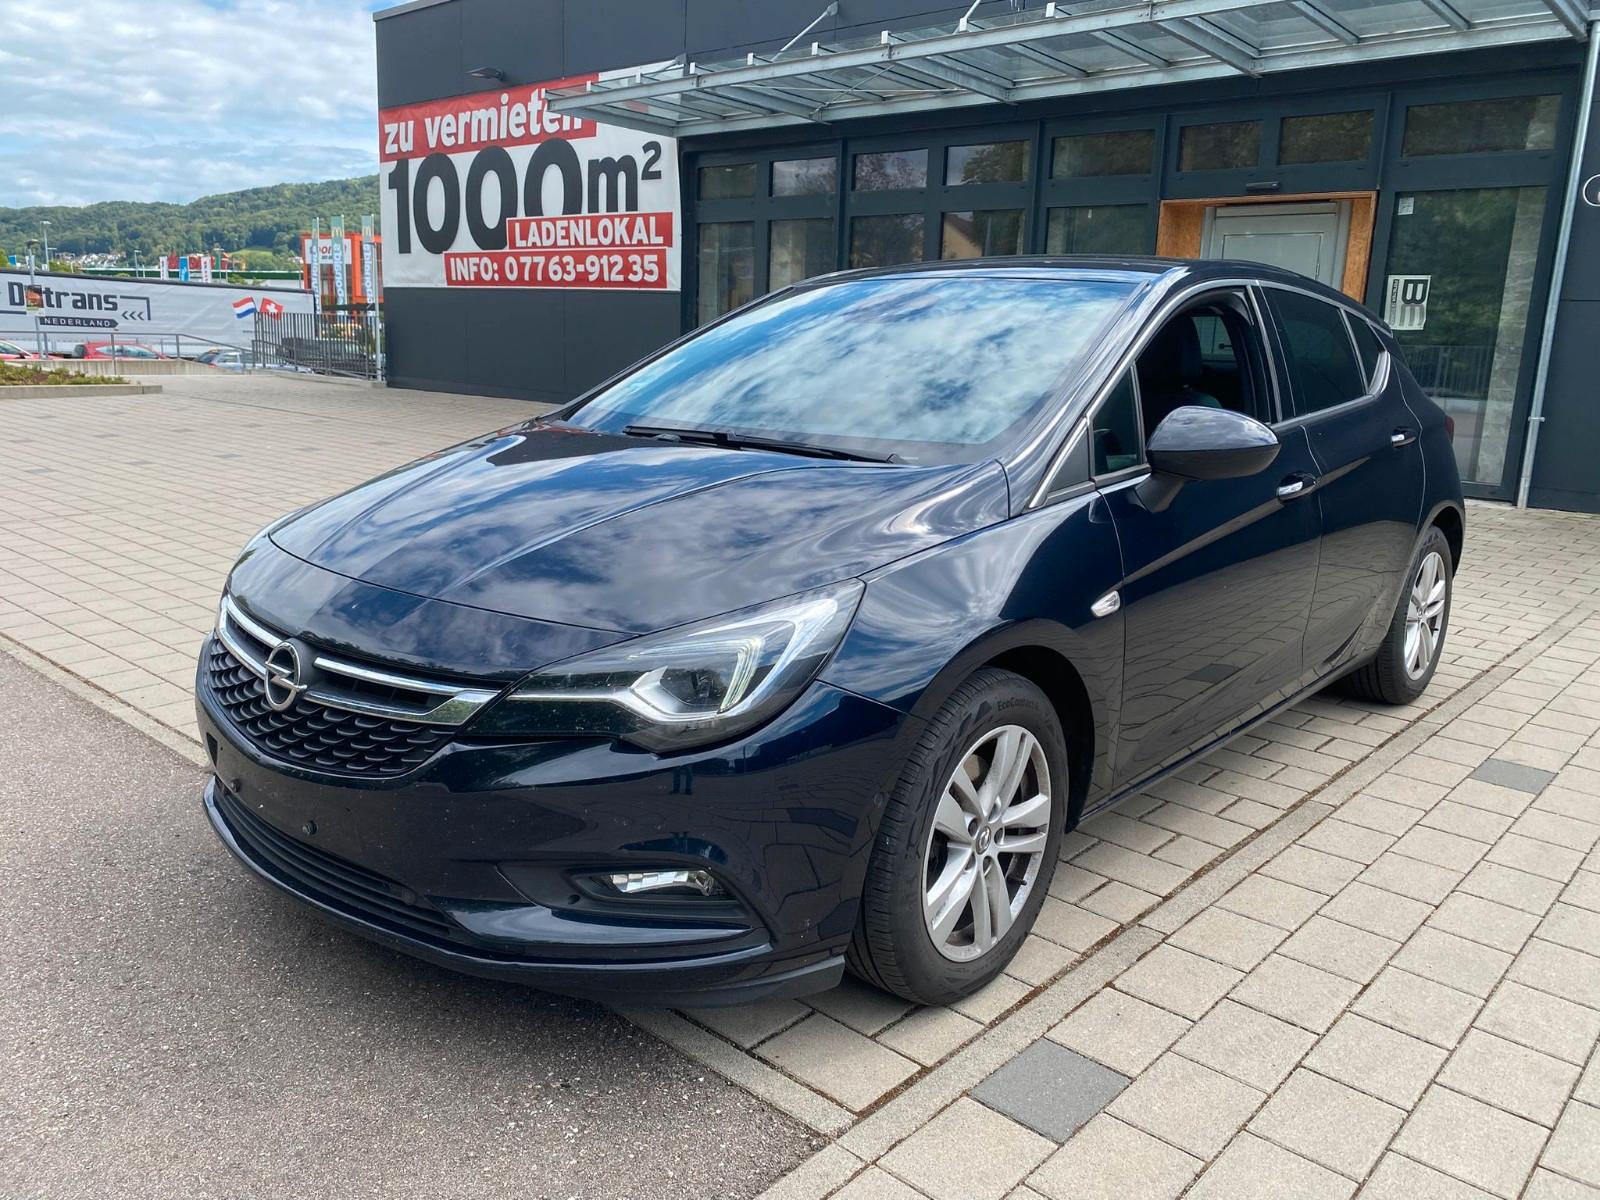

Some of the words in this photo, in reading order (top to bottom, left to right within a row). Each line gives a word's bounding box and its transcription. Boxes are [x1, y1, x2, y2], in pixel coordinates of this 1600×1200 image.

[384, 120, 414, 154] zu
[514, 216, 664, 247] LADENLOKAL
[450, 257, 499, 281] INFO:
[8, 281, 118, 311] Dtrans
[44, 317, 111, 328] NEDERLAND
